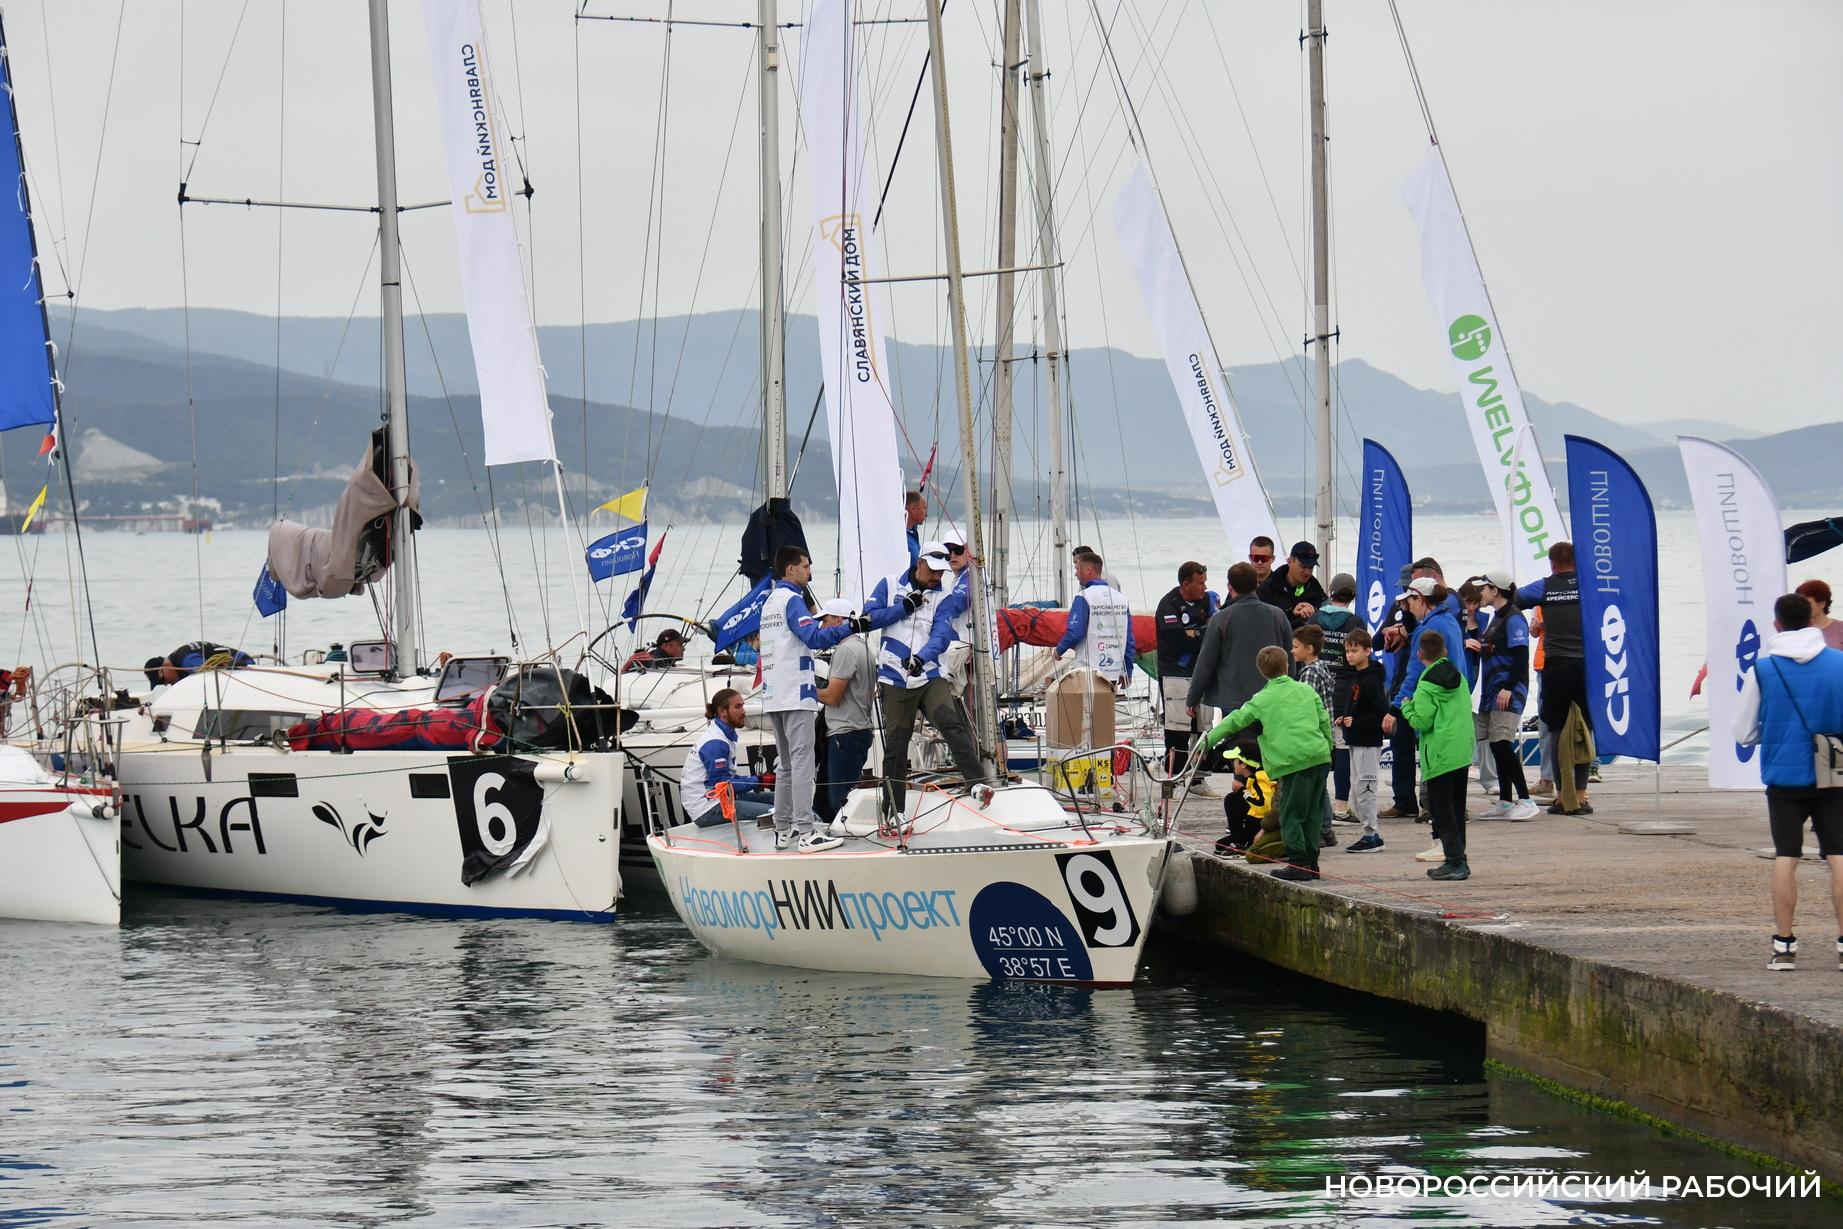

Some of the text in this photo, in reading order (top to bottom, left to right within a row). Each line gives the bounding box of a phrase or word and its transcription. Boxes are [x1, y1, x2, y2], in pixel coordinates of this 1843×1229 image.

[844, 228, 861, 269] ДОМ
[473, 772, 517, 857] 6
[678, 875, 963, 941] НовоморНИИпроект
[1064, 854, 1133, 947] 9
[989, 926, 1064, 947] 45°00 N
[999, 957, 1076, 978] 38°57 E
